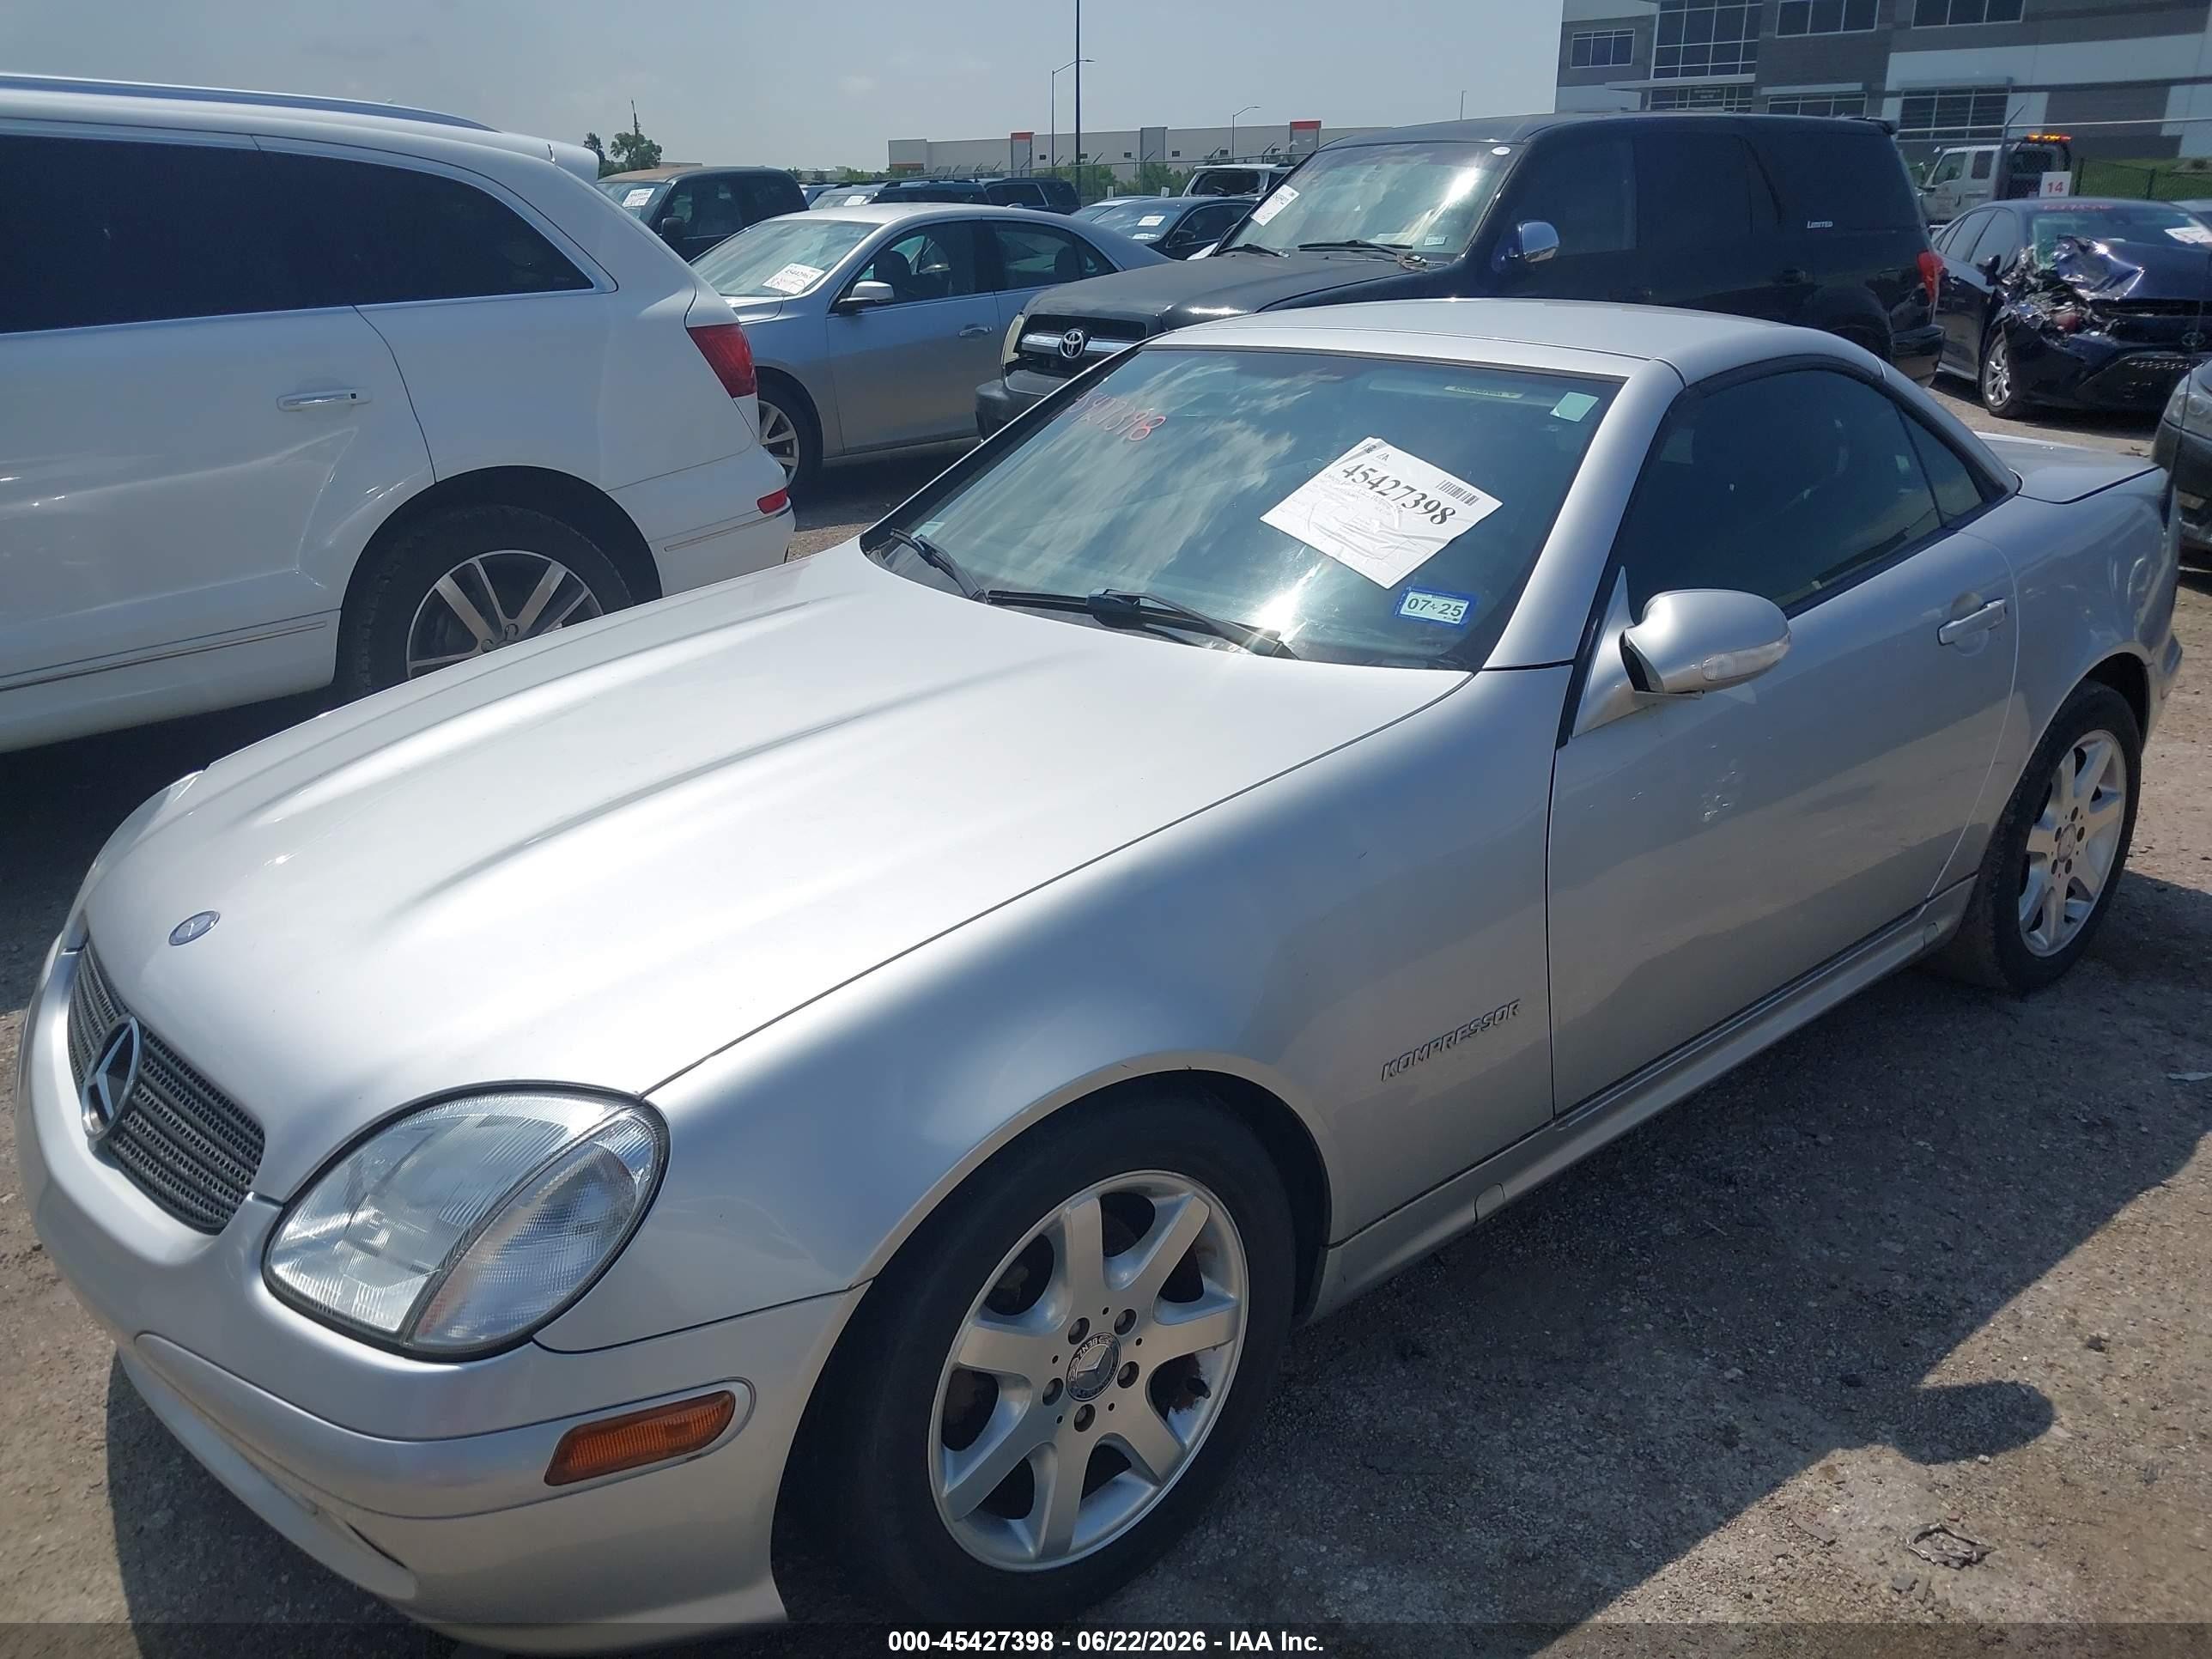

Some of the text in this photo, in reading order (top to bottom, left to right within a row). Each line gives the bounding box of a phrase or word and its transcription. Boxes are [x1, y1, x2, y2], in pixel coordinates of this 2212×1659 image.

[2047, 181, 2063, 193] 14
[1341, 463, 1456, 525] 45427398
[1381, 998, 1521, 1082] KOMPRESSOR
